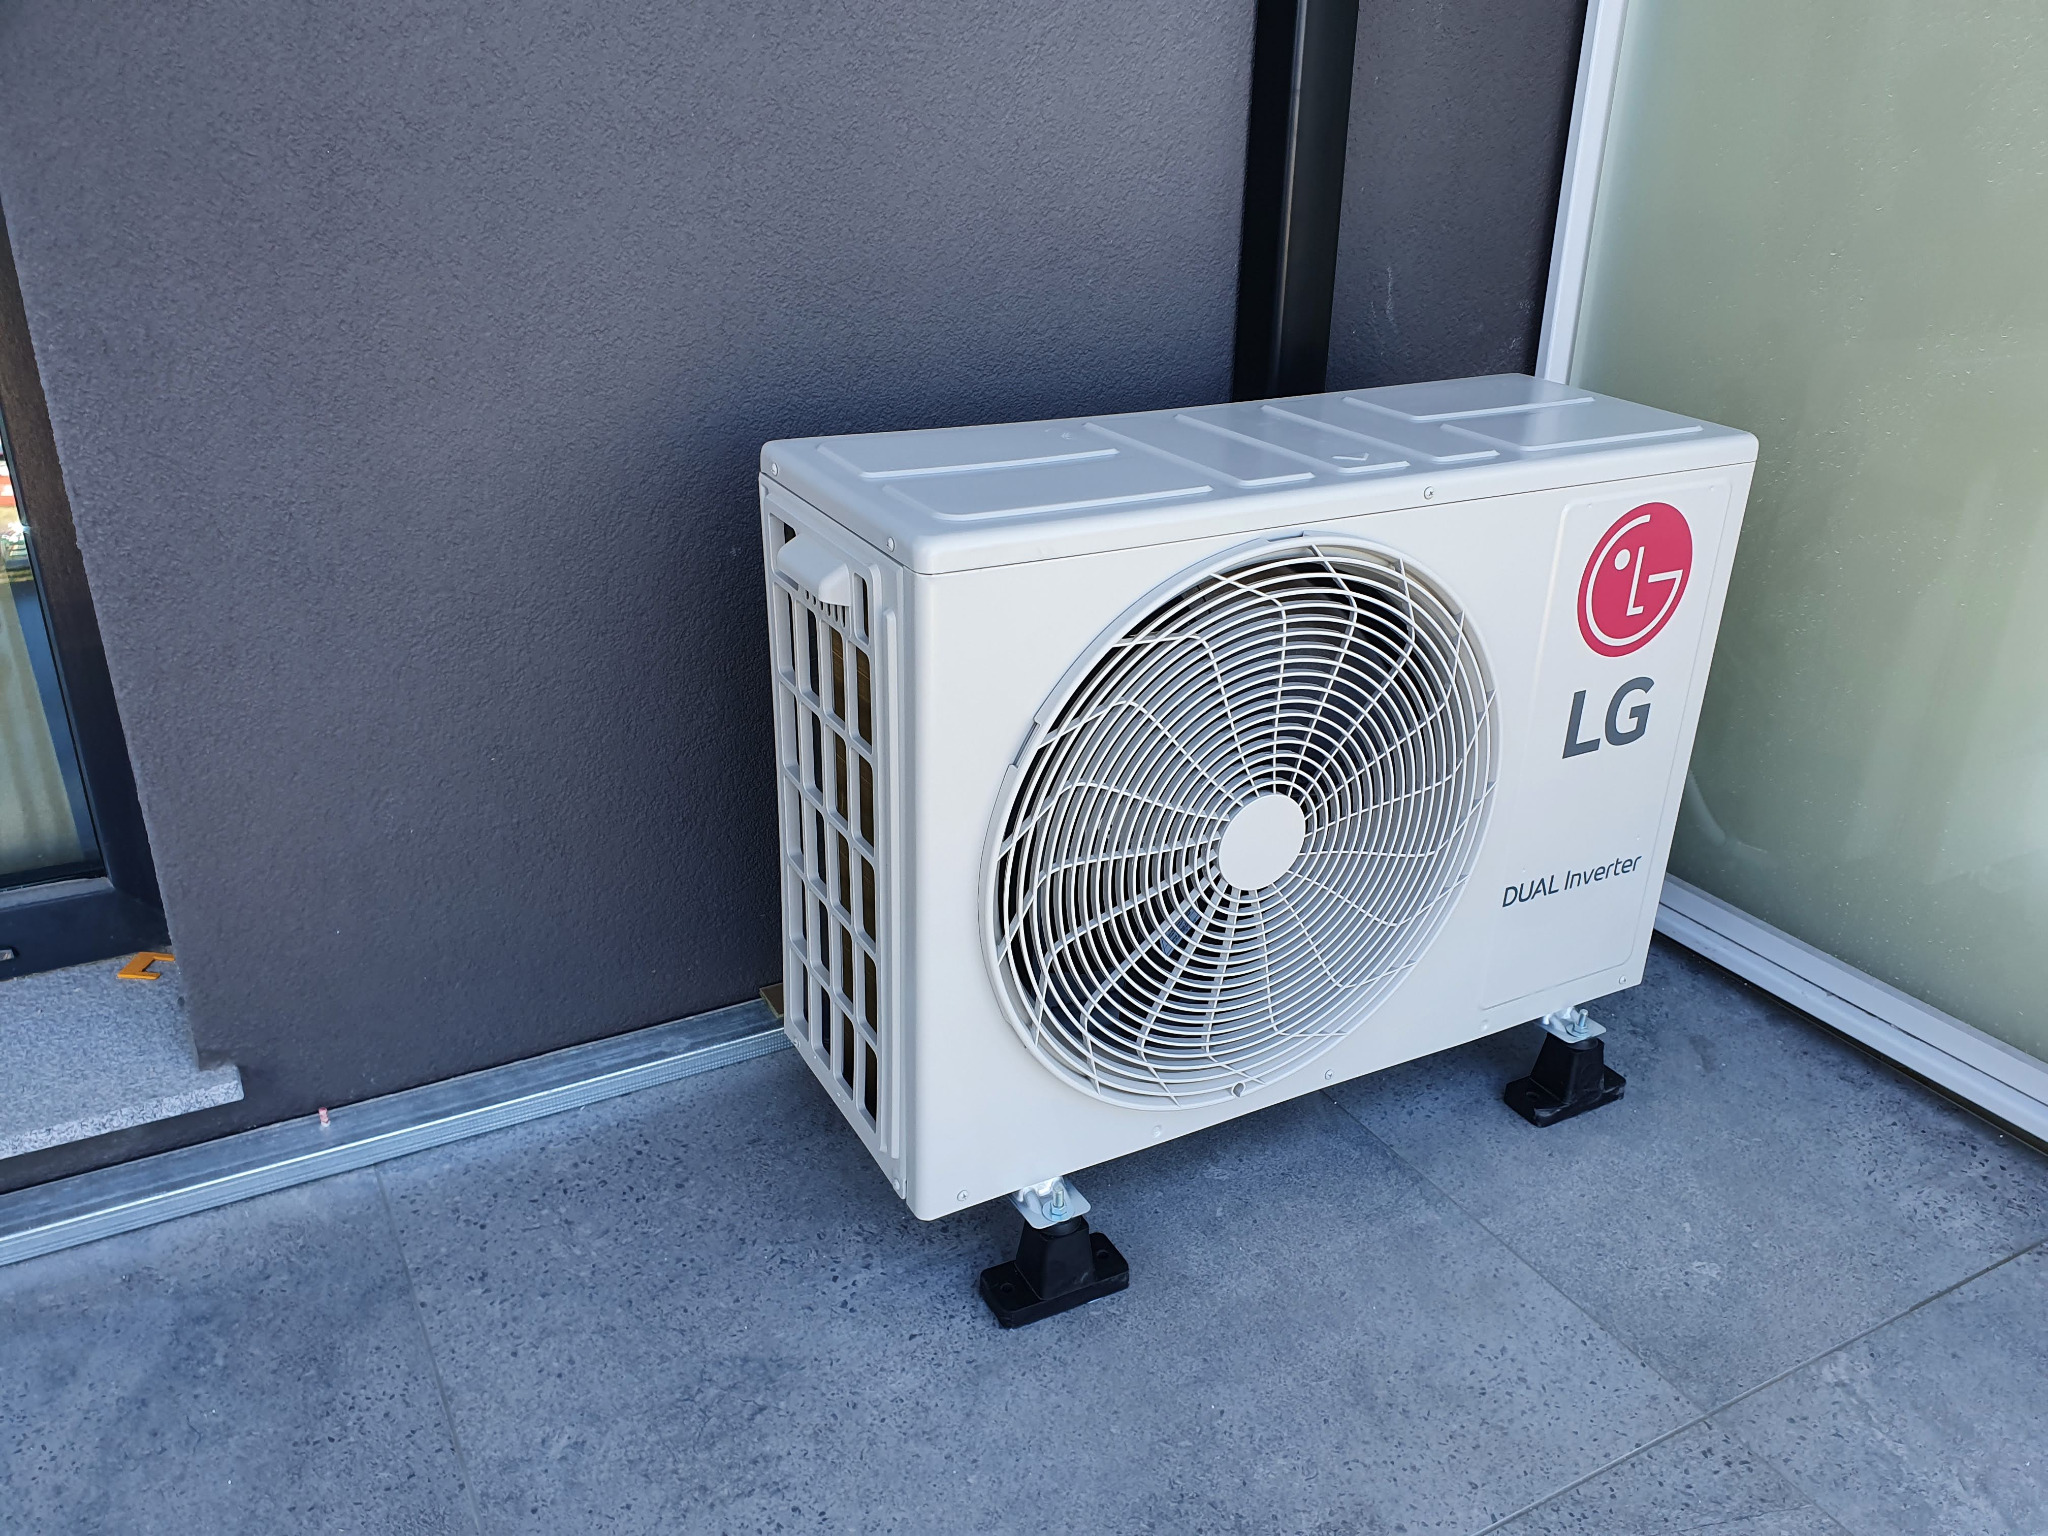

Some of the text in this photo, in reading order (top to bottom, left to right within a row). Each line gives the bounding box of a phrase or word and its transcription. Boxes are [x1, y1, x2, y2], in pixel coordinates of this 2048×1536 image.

[1562, 676, 1655, 759] LG
[1502, 855, 1642, 907] DUAL Inverter
